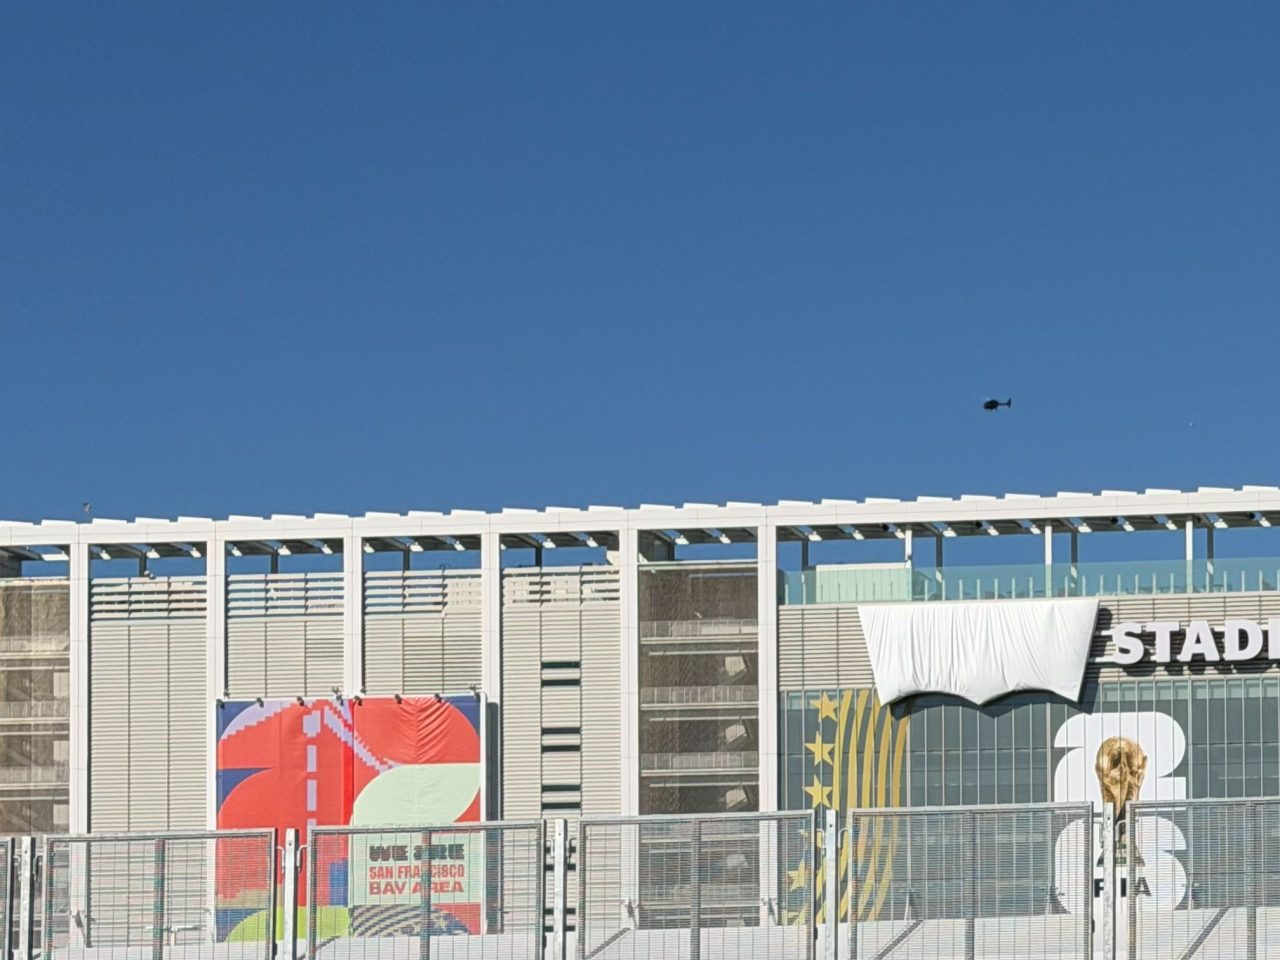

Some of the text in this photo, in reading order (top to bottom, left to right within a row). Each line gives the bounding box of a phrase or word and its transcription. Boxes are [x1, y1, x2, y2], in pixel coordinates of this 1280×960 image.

[369, 845, 409, 862] WE
[369, 864, 465, 879] SAN FRACISCO
[369, 881, 407, 895] BAY
[1094, 877, 1152, 897] FA
